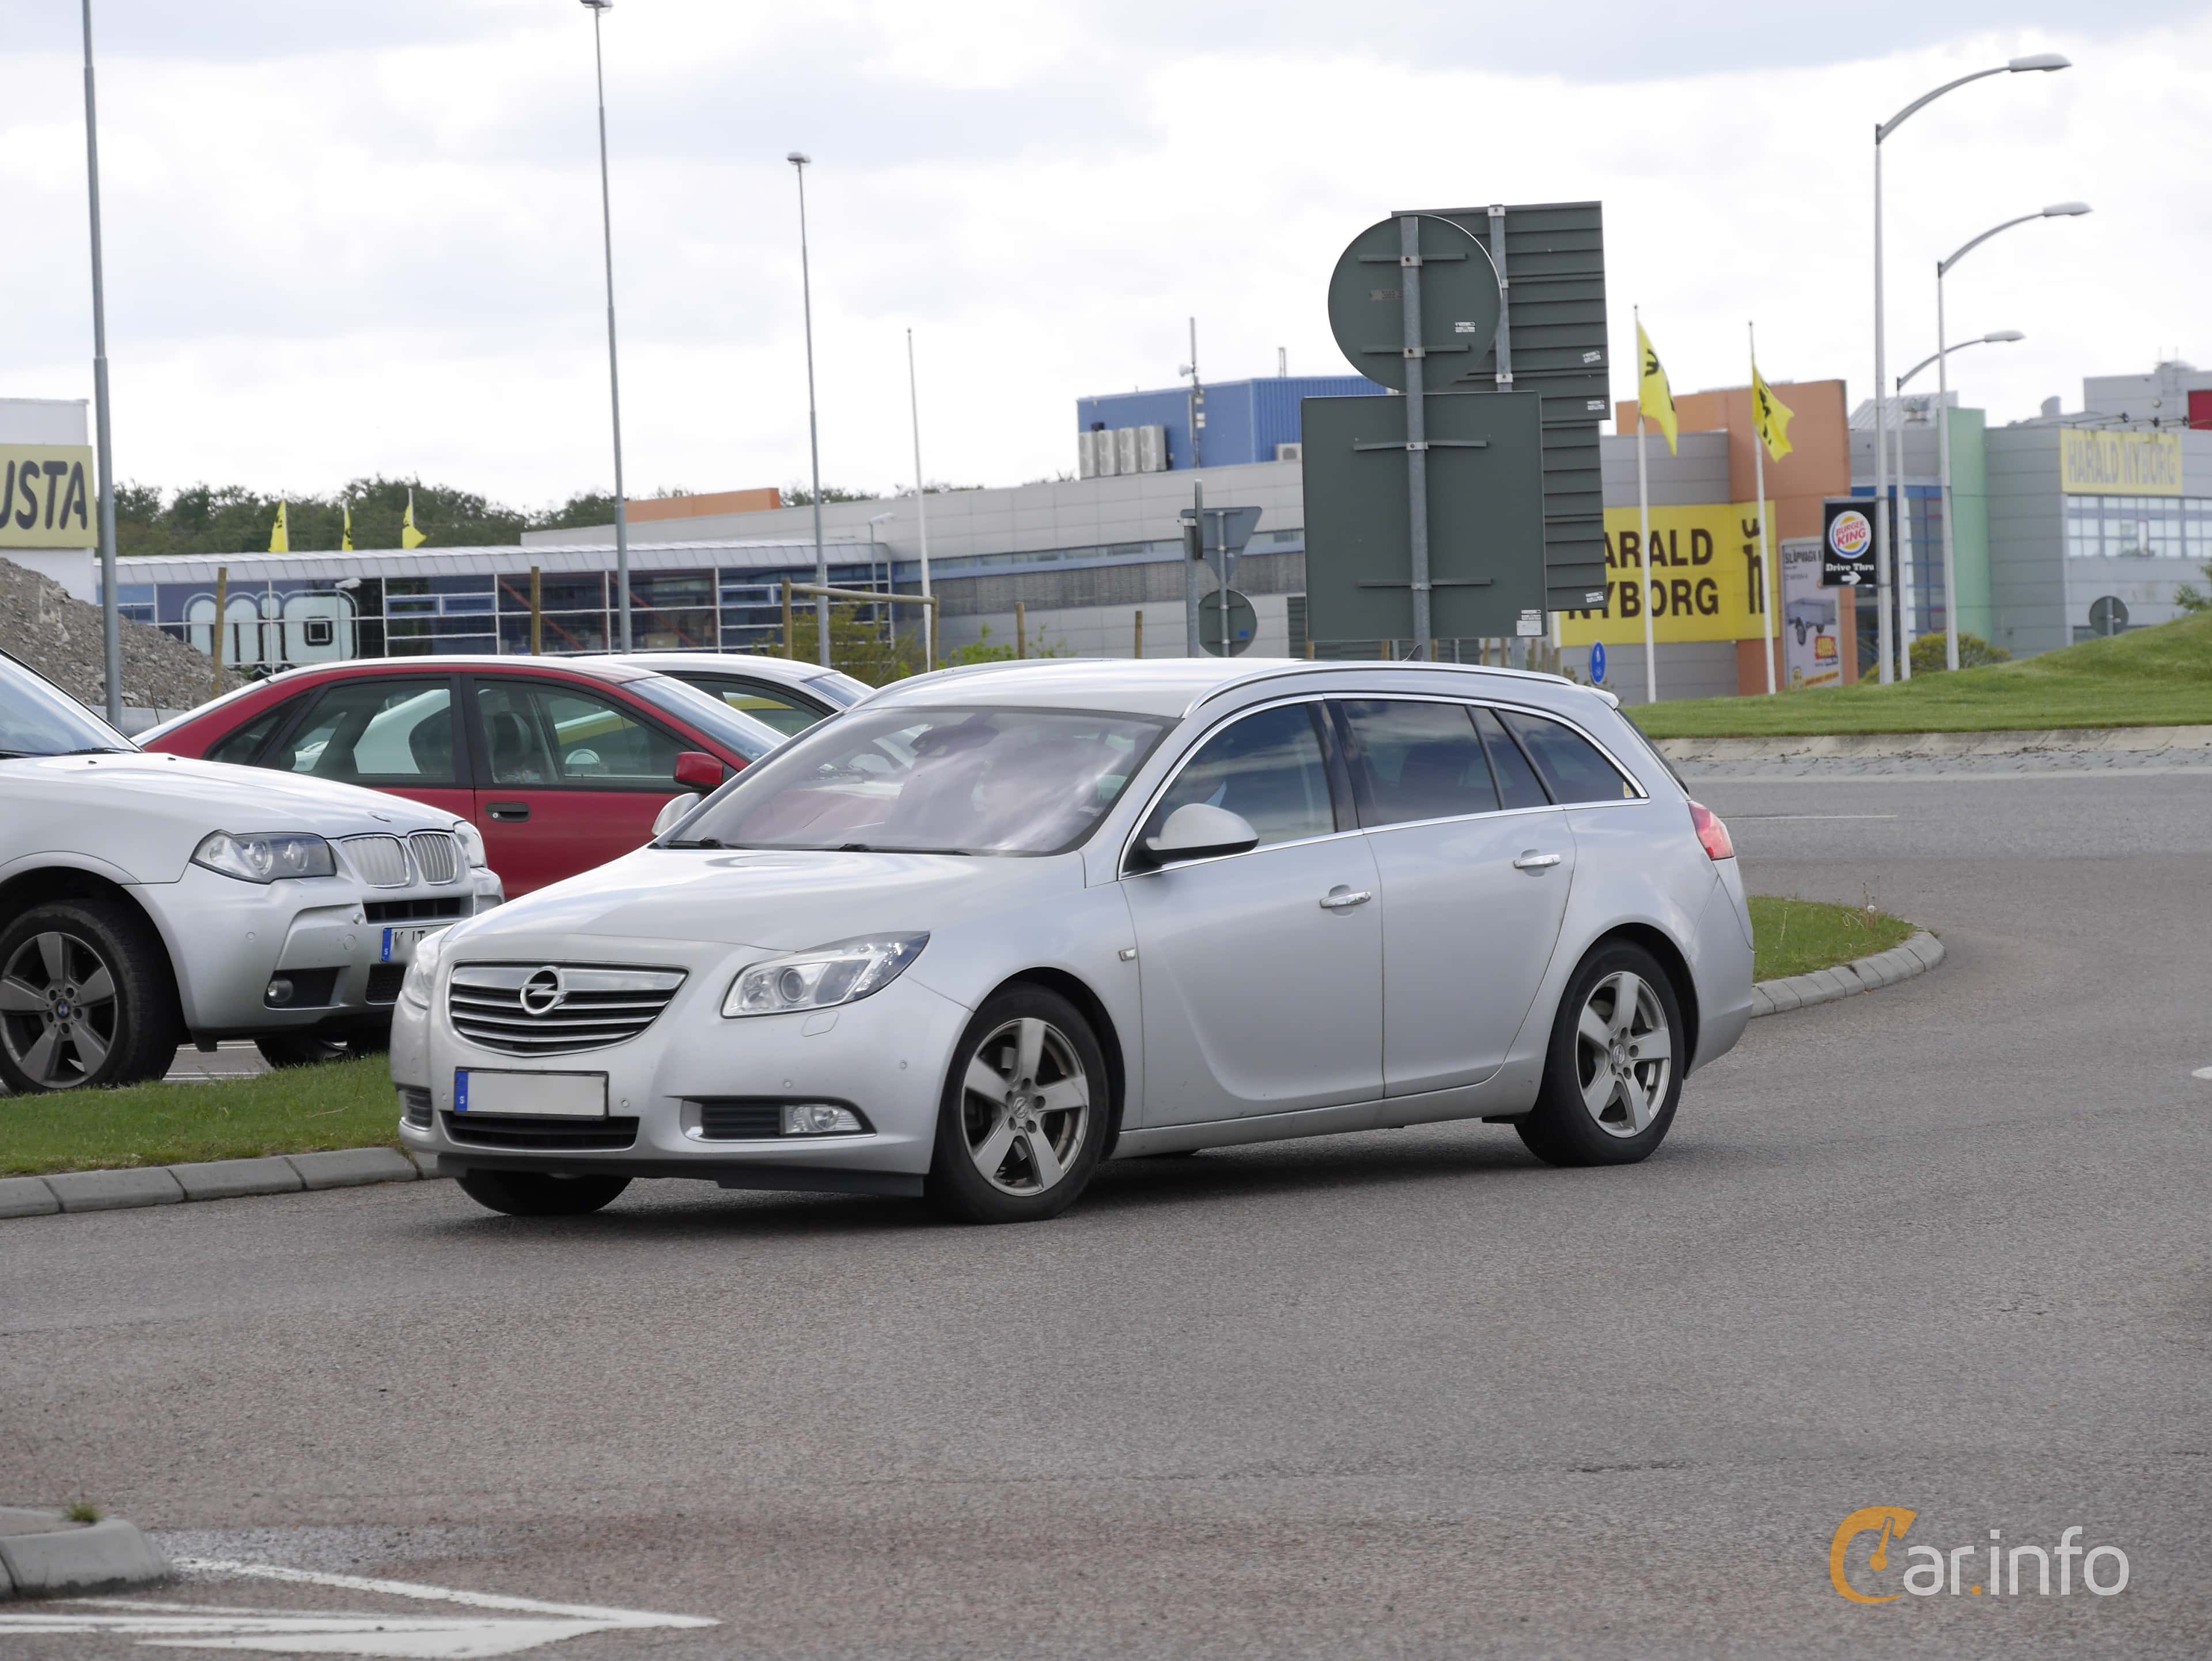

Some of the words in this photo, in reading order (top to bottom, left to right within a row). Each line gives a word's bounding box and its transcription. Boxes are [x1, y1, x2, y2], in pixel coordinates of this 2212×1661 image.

[2067, 440, 2119, 483] HARALD
[1836, 520, 1865, 536] BURGER
[1836, 528, 1866, 548] KING
[1604, 528, 1713, 569] ARALD
[1825, 563, 1851, 572] Drive
[1853, 562, 1874, 571] Thru
[1568, 577, 1719, 620] YBORG
